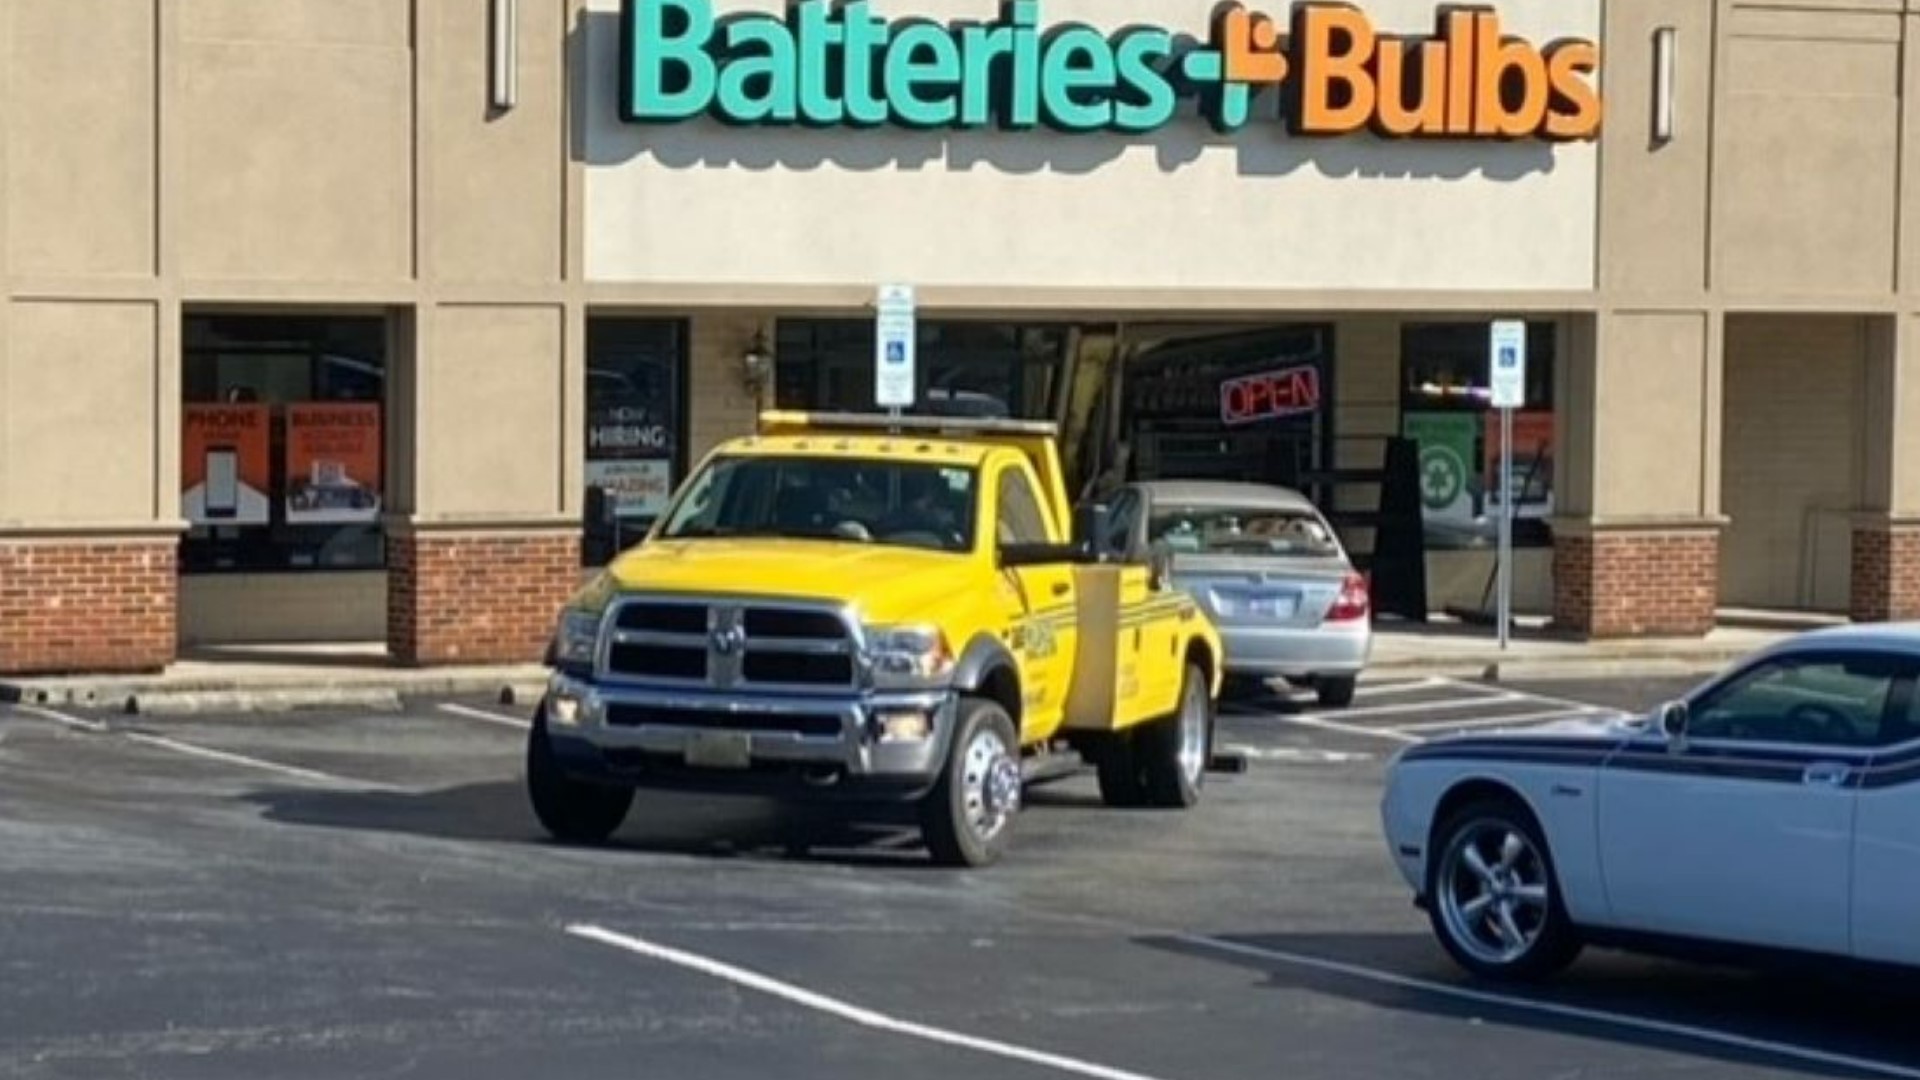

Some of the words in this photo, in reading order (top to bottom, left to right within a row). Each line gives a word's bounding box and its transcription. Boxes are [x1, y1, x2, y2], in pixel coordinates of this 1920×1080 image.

[630, 0, 1176, 128] Batteries
[1302, 6, 1601, 137] Bulbs
[1227, 370, 1316, 416] OPEN
[187, 410, 257, 427] PHONE
[589, 425, 666, 447] HIRING
